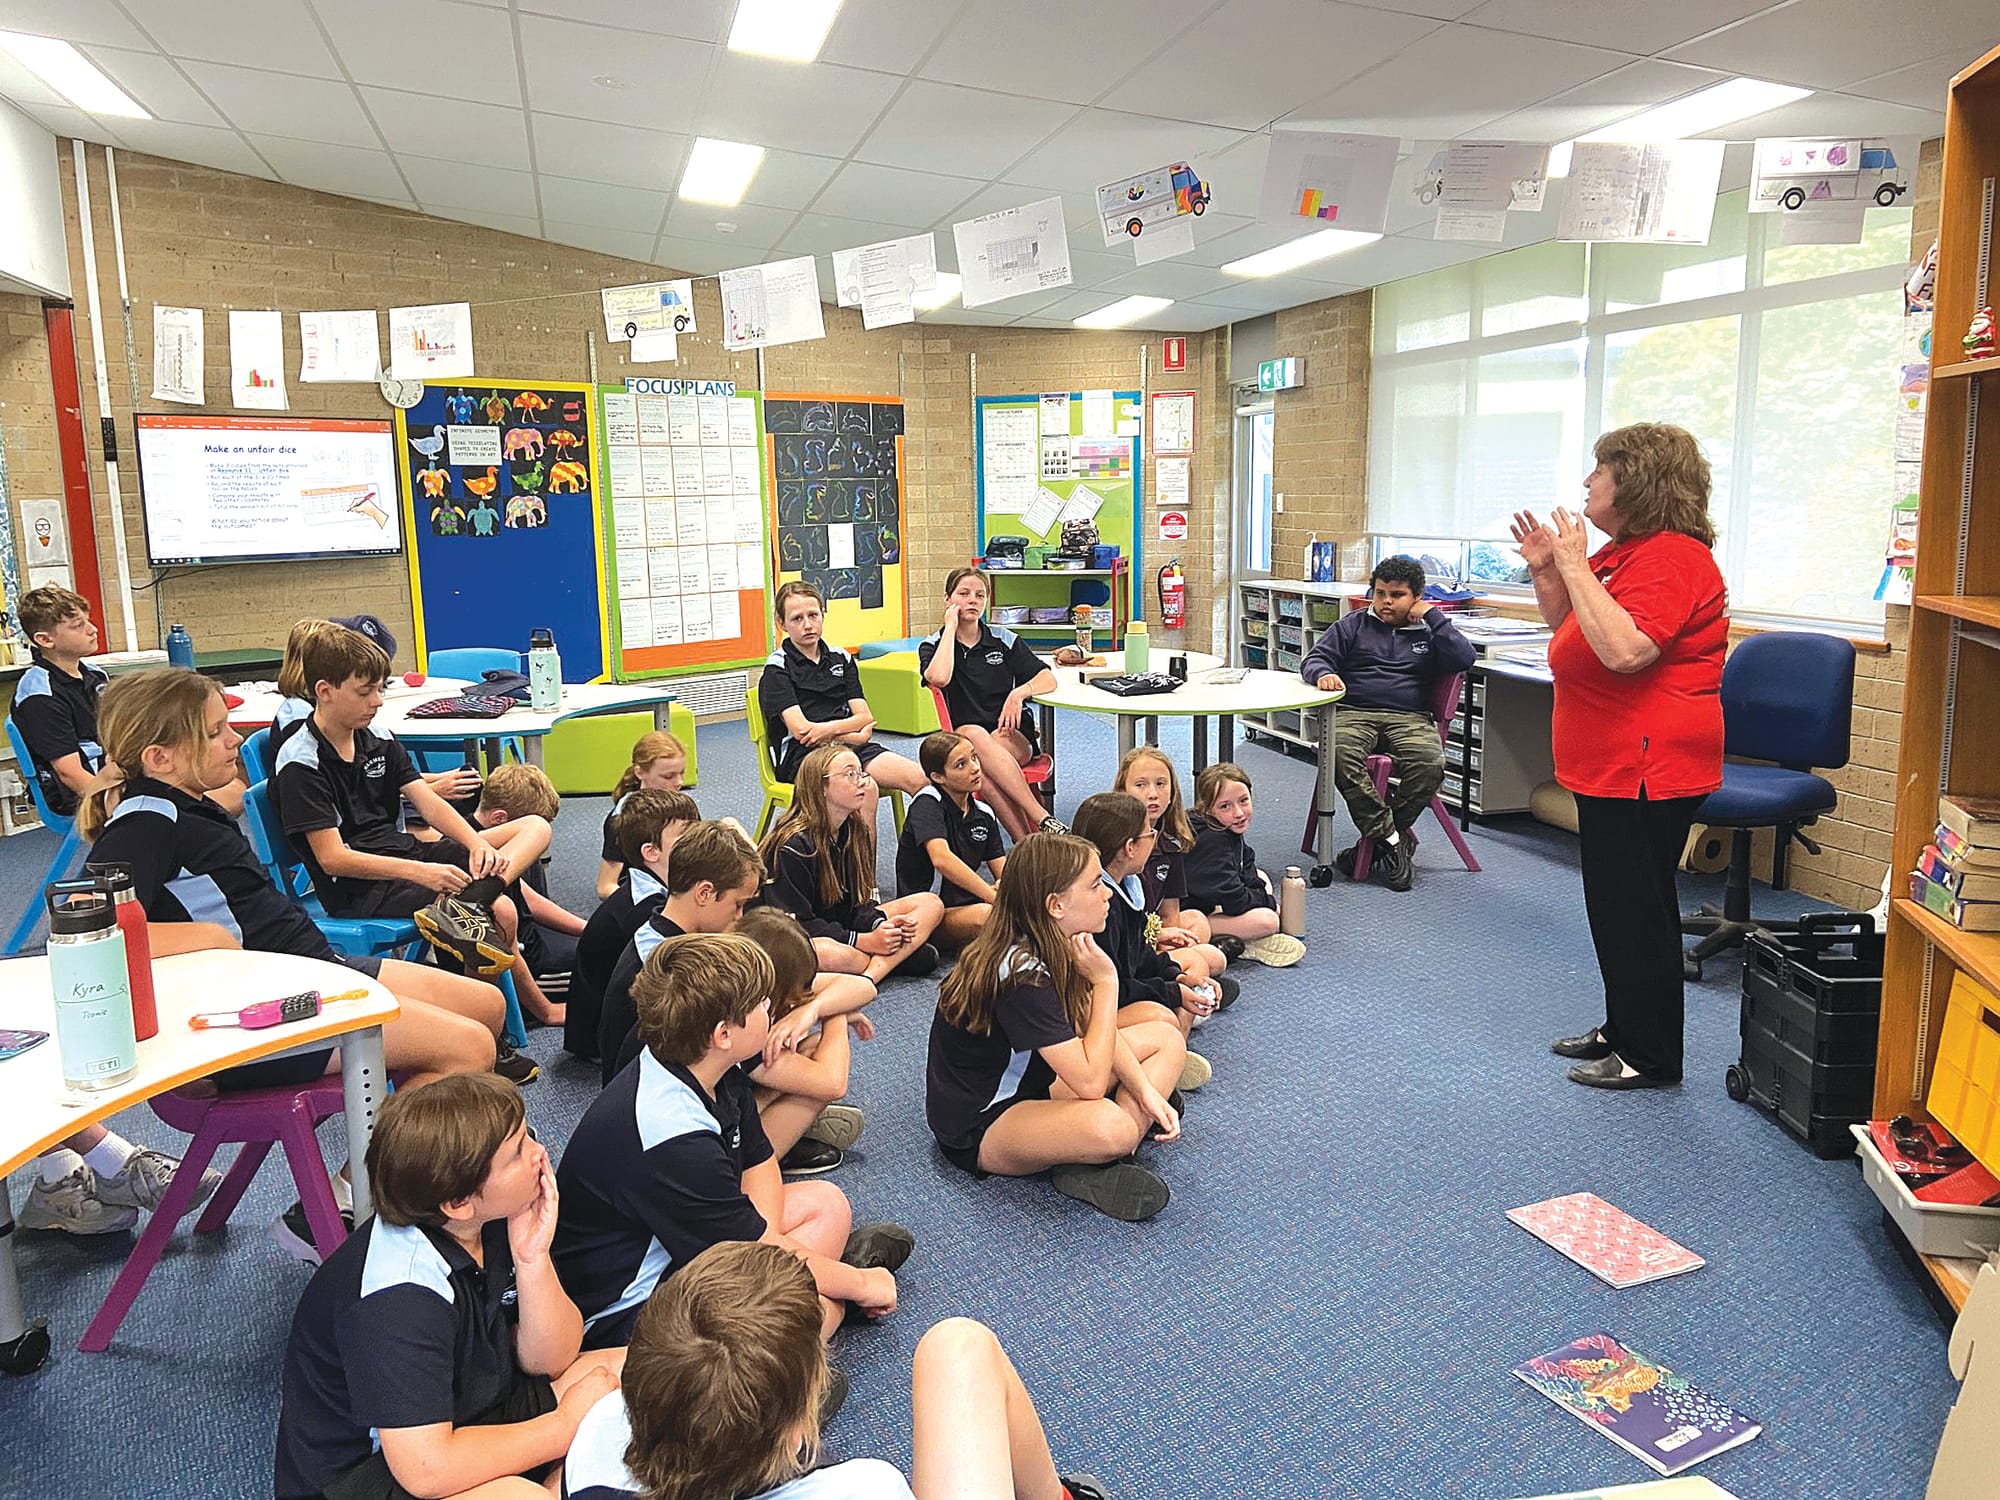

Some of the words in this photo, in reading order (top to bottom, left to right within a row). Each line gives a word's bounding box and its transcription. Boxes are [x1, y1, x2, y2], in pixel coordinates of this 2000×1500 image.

[626, 378, 681, 395] FOCUS
[684, 380, 735, 397] PLANS
[204, 445, 229, 453] Make
[233, 445, 244, 453] an
[248, 445, 275, 453] unfair
[279, 445, 297, 453] dice
[72, 983, 105, 998] Kyra
[90, 1060, 117, 1072] YETI
